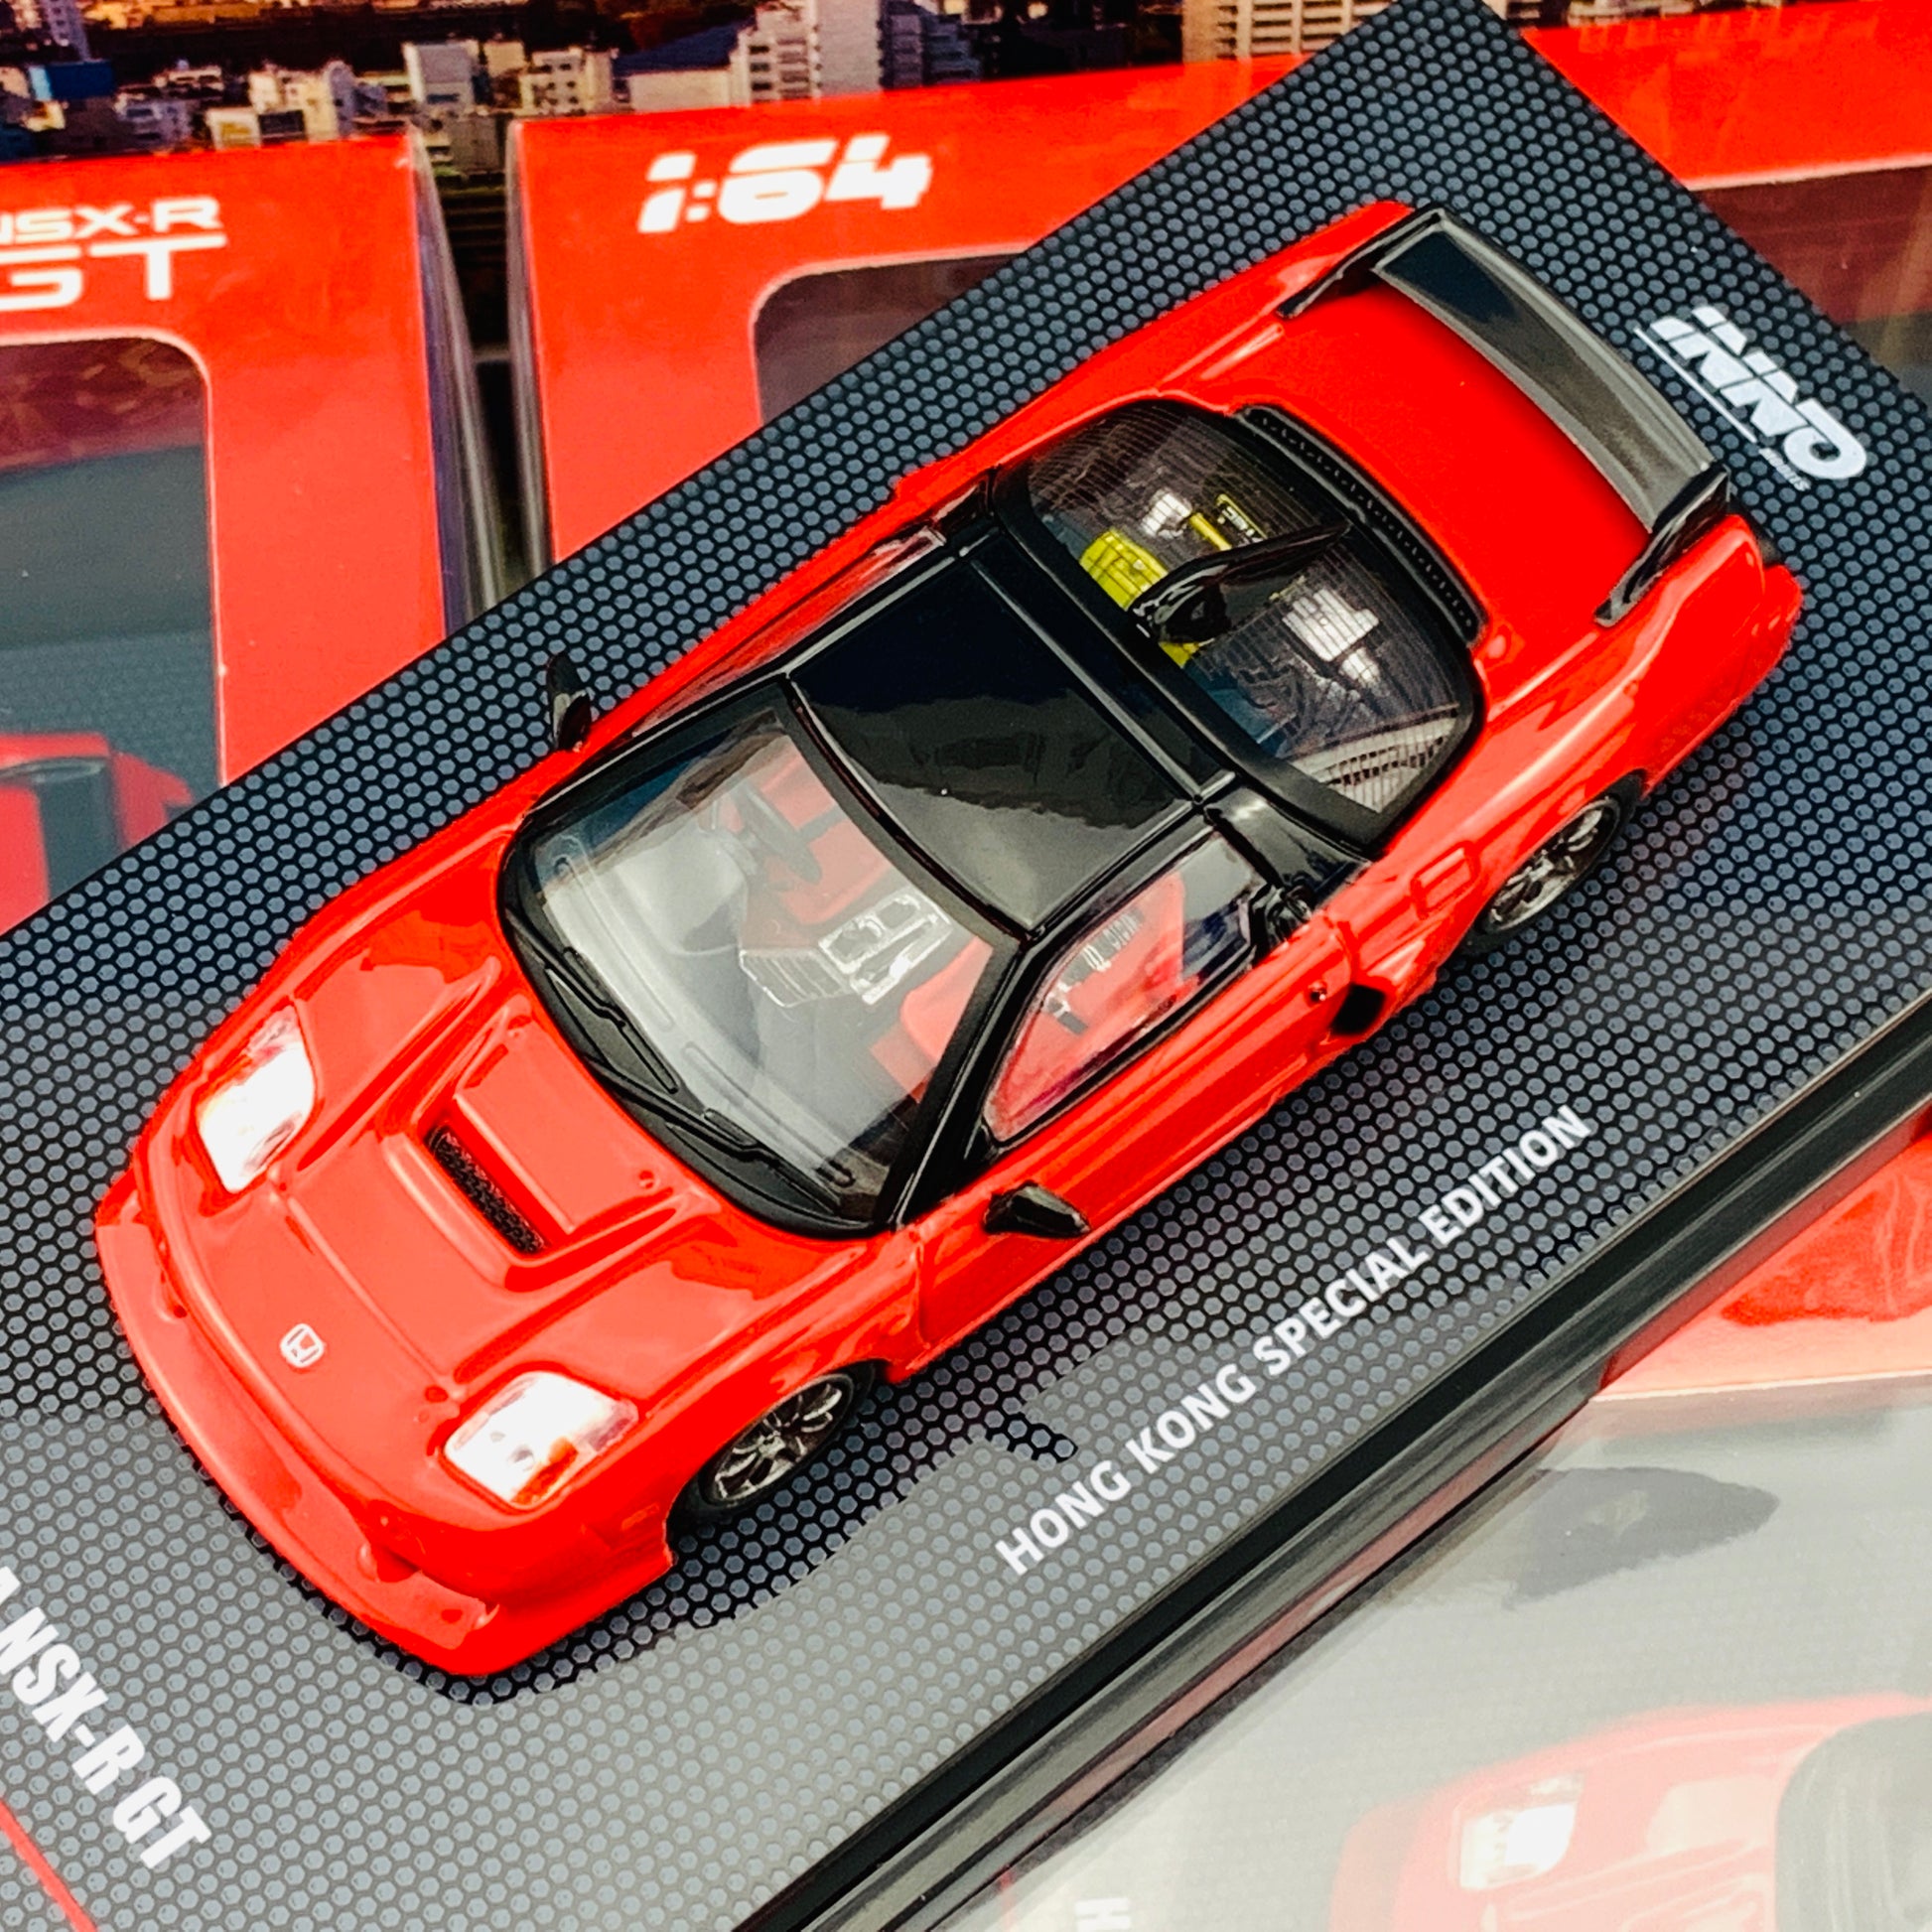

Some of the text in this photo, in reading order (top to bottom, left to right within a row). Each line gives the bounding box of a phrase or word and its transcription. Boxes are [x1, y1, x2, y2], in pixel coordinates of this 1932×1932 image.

[0, 197, 222, 245] SX-R
[1648, 305, 1867, 481] INNO
[994, 1104, 1592, 1577] HONG KONG SPECIAL EDITION
[0, 1605, 212, 1870] NSX-R GT
